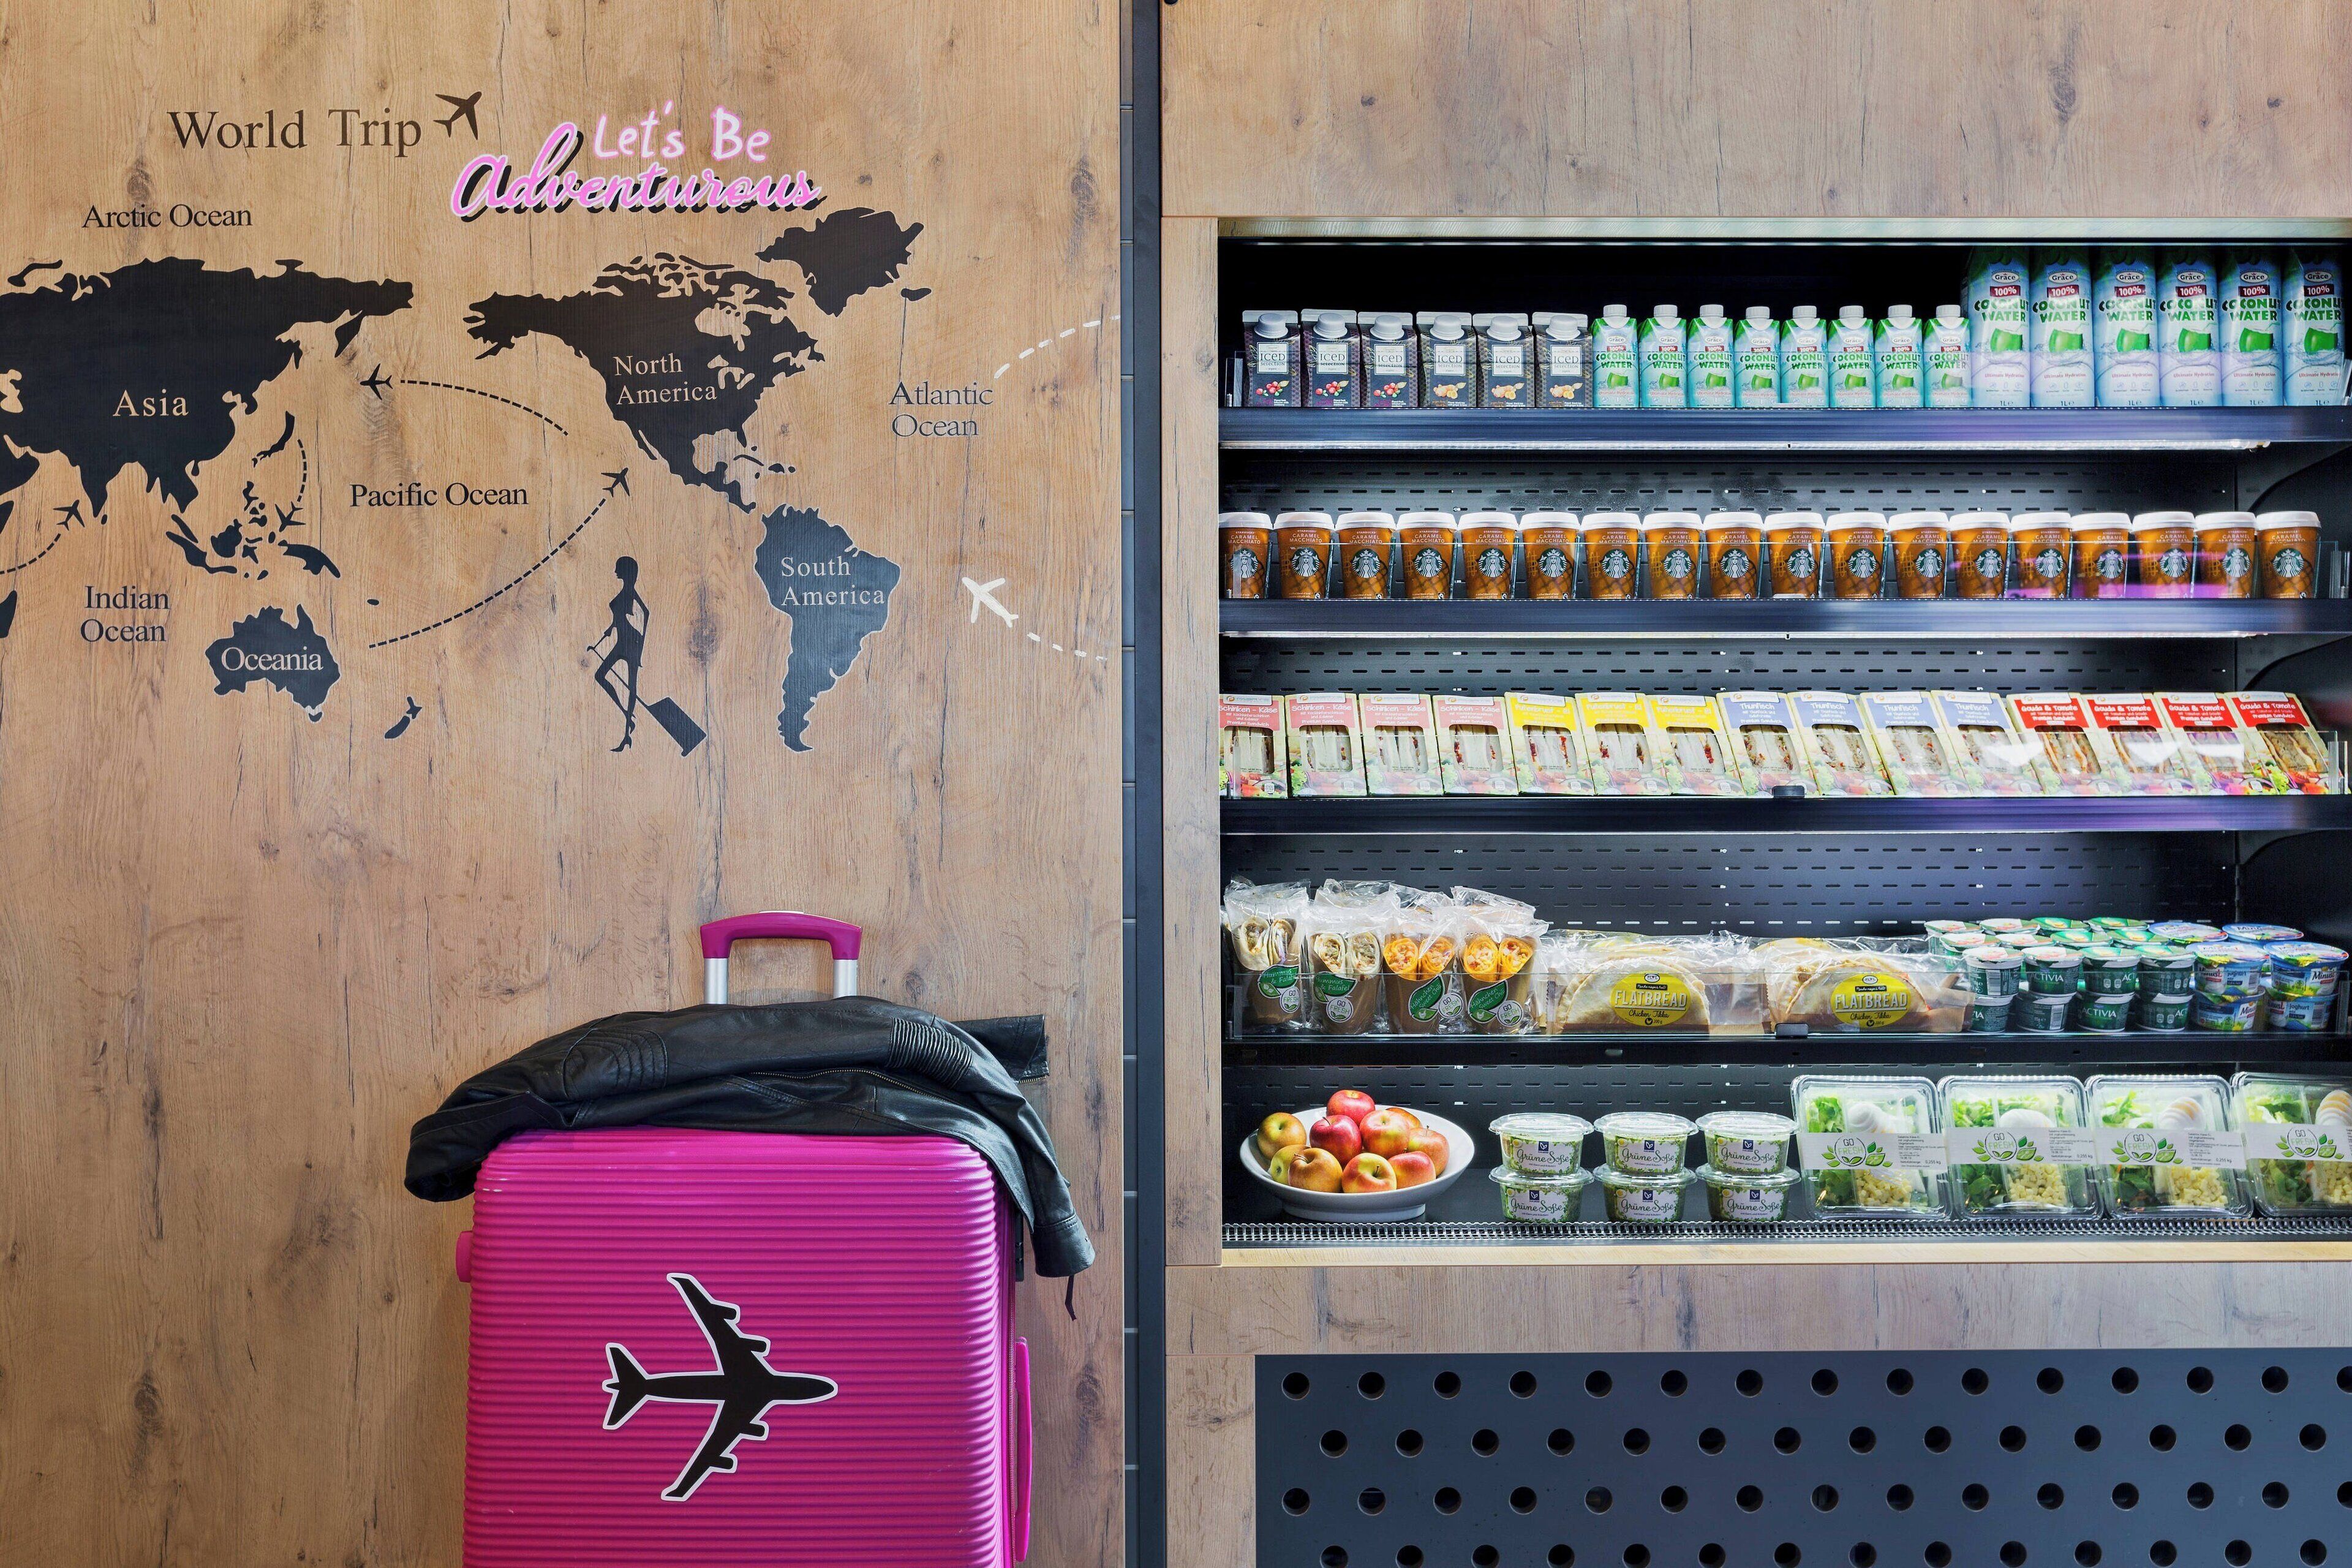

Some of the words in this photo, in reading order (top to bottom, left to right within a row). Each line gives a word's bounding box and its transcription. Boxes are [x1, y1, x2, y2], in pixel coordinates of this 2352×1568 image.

[167, 110, 307, 149] World
[328, 108, 421, 157] Trip
[594, 100, 685, 160] Let's
[711, 105, 771, 162] Be
[451, 123, 824, 219] Adventurous
[82, 204, 161, 228] Arctic
[170, 203, 252, 227] Ocean
[1994, 286, 2016, 296] 100%
[2051, 287, 2075, 296] 100%
[2119, 286, 2141, 296] 100%
[2180, 286, 2202, 296] 100%
[2243, 286, 2266, 296] 100%
[2307, 285, 2329, 295] 100%
[2222, 298, 2281, 311] COCONUT
[2040, 311, 2086, 323] WATER
[2106, 311, 2153, 322] WATER
[2168, 311, 2214, 322] WATER
[2230, 311, 2277, 321] WATER
[2294, 310, 2342, 321] WATER
[1881, 353, 1921, 362] COCONUT
[614, 354, 682, 376] North
[616, 383, 717, 406] America
[889, 381, 993, 407] Atlantic
[113, 390, 188, 417] Asia
[892, 414, 979, 437] Ocean
[350, 483, 437, 507] Pacific
[446, 482, 528, 505] Ocean
[781, 556, 850, 576] South
[85, 585, 170, 610] Indian
[781, 584, 885, 605] America
[80, 619, 166, 643] Ocean
[221, 646, 323, 671] Oceania
[1442, 997, 1452, 1005] GO
[1442, 998, 1459, 1012] FRESH
[1615, 990, 1687, 1008] FLATBREAD
[1835, 992, 1907, 1009] FLATBREAD
[1330, 1005, 1350, 1014] FRESH
[2082, 1008, 2116, 1017] ACTIVIA
[1844, 1138, 1854, 1147] GO
[2133, 1134, 2144, 1142] GO
[1838, 1146, 1864, 1155] FRESH
[1988, 1141, 2014, 1150] FRESH
[2127, 1142, 2153, 1151] FRESH
[1517, 1149, 1547, 1163] Grüne
[1547, 1151, 1569, 1165] Soße
[1622, 1148, 1653, 1162] Grüne
[1653, 1150, 1675, 1164] Soße
[1721, 1147, 1751, 1161] Grüne
[1752, 1150, 1774, 1163] Soße
[1510, 1199, 1538, 1212] Grüne
[1539, 1200, 1562, 1213] Soße
[1621, 1199, 1652, 1213] Grüne
[1652, 1200, 1674, 1213] Soße
[1727, 1199, 1758, 1213] Grüne
[1759, 1199, 1780, 1212] Soße
